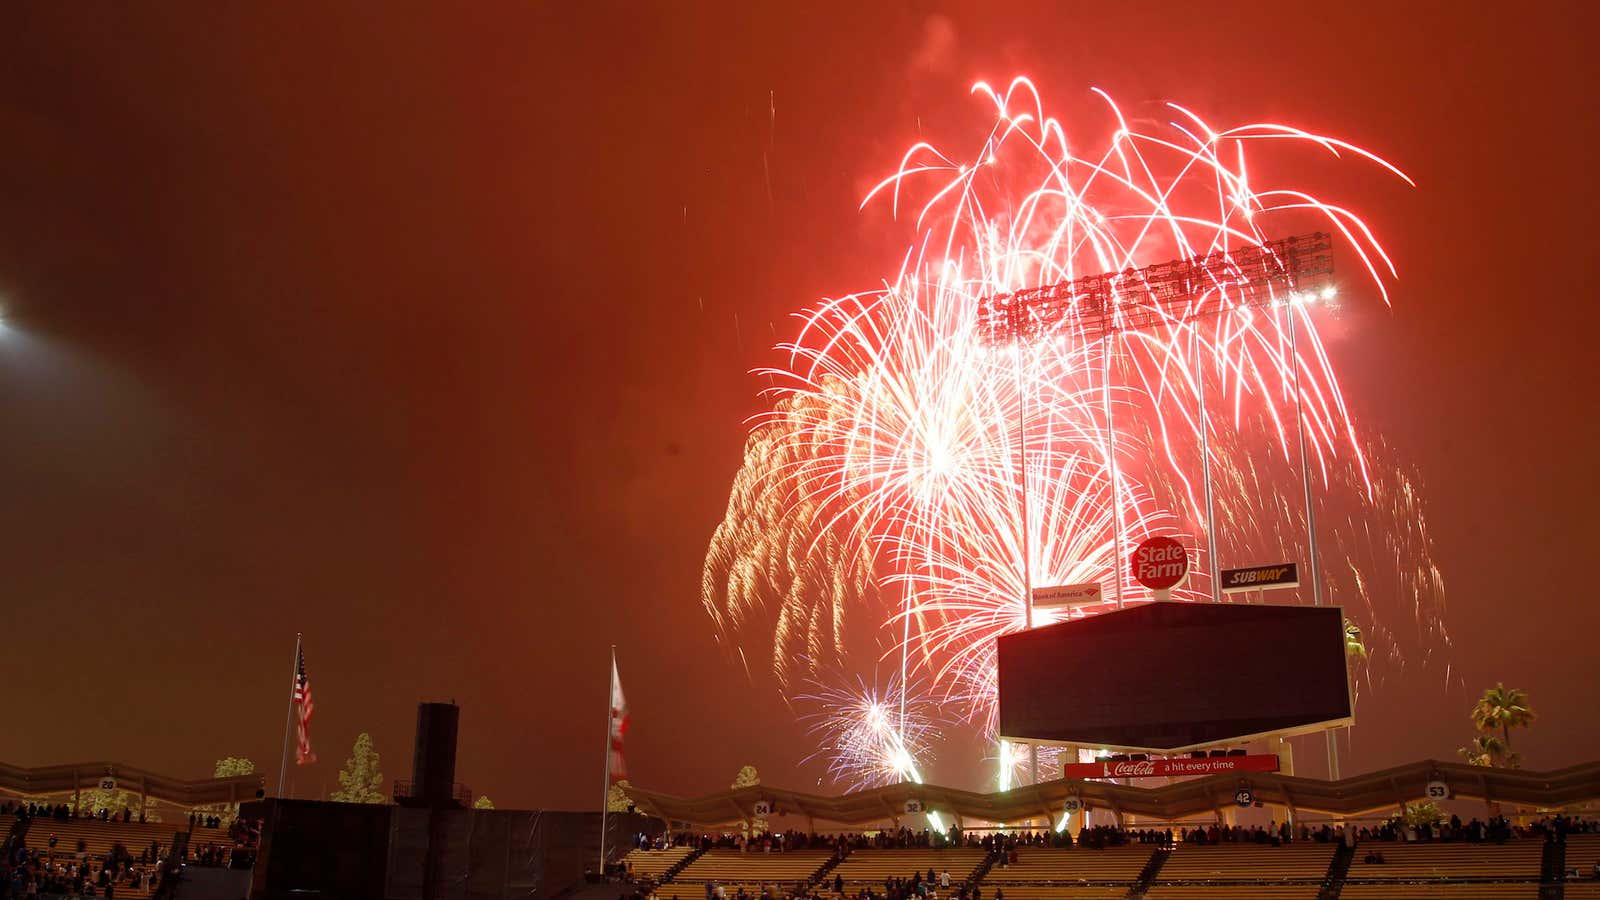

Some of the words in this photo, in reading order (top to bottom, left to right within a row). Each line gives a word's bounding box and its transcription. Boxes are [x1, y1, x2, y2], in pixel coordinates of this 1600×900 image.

[1137, 545, 1184, 563] State
[1137, 562, 1184, 580] Farm
[1230, 568, 1288, 584] SUBWAY
[1057, 590, 1083, 598] America
[1172, 762, 1184, 771] hit
[1186, 763, 1211, 772] every
[1213, 761, 1234, 769] time
[1430, 786, 1445, 797] 53
[1236, 792, 1250, 803] 42
[756, 805, 768, 814] 24
[907, 803, 918, 813] 32
